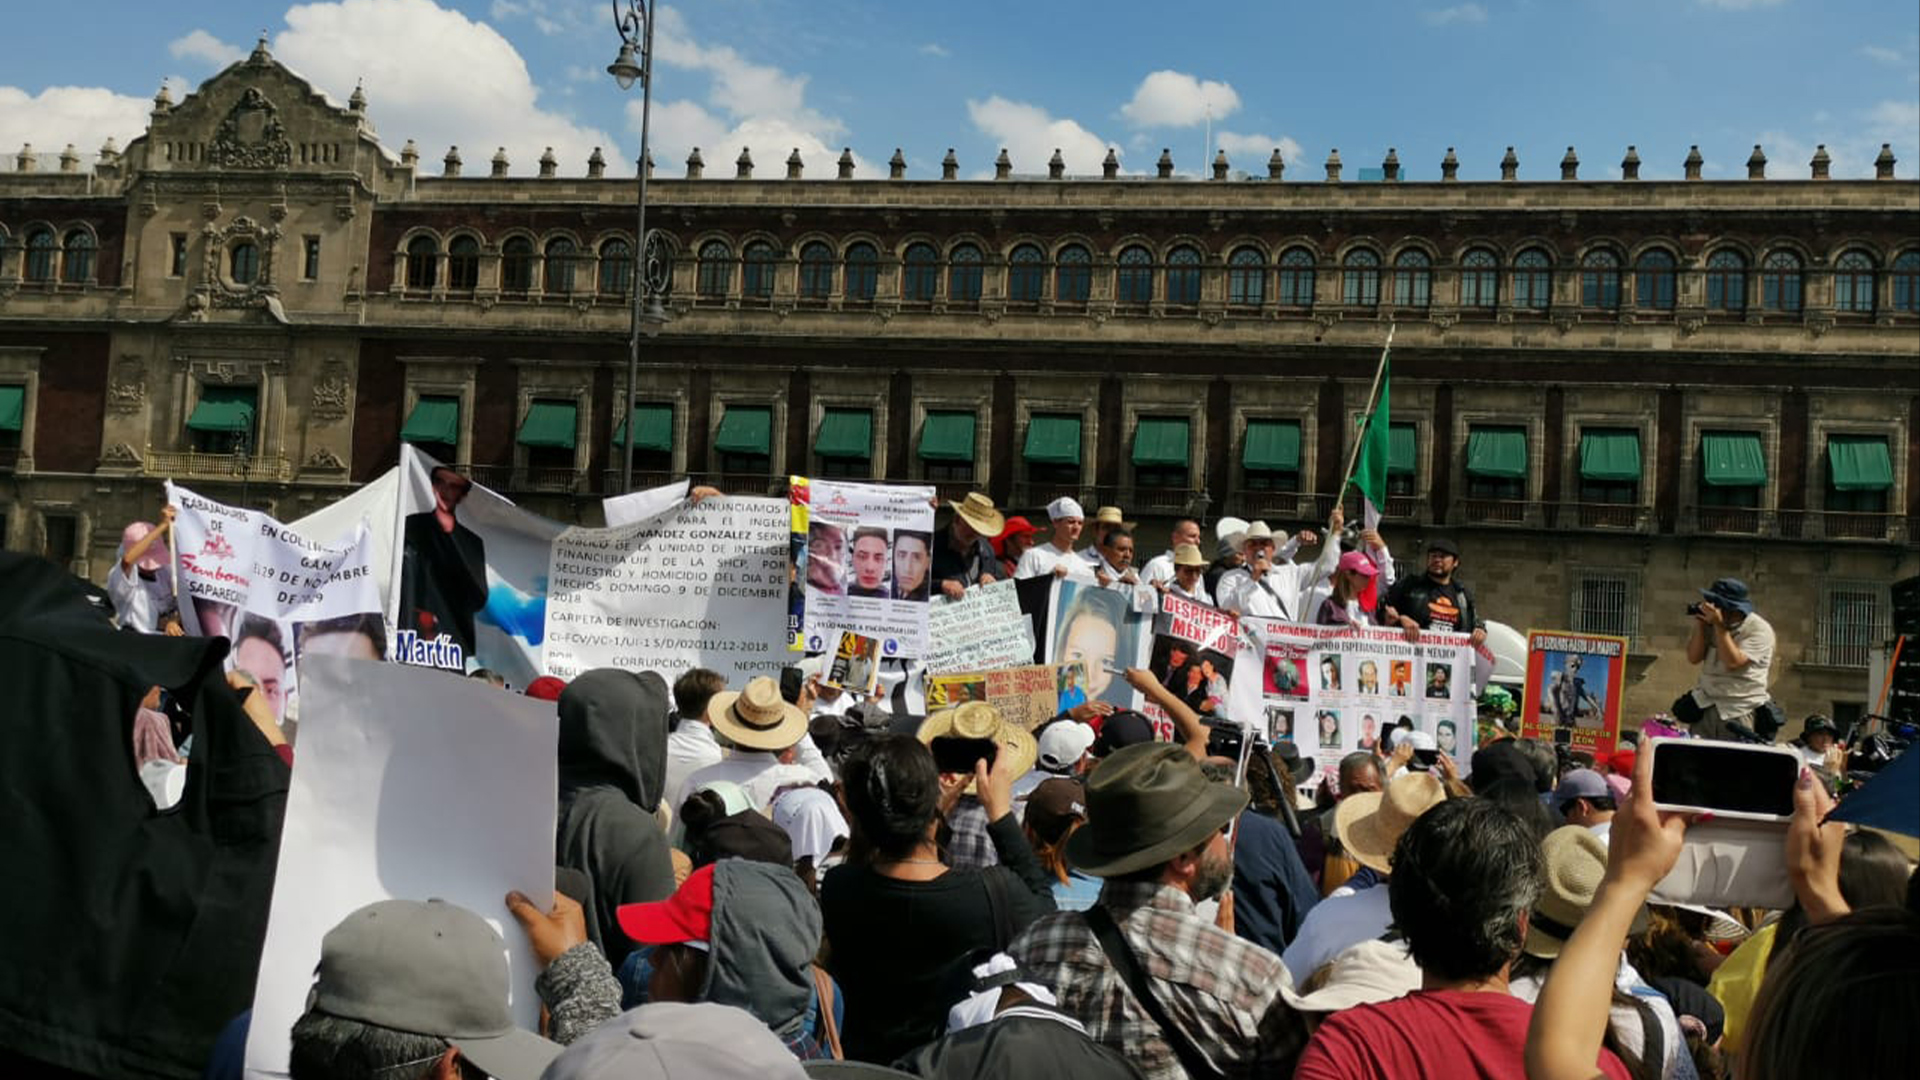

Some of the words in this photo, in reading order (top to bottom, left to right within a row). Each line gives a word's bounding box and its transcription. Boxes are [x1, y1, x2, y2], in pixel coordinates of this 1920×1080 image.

[683, 501, 781, 516] PRONUNCIAMOS
[211, 519, 223, 535] DE
[677, 515, 708, 526] PARA
[722, 516, 734, 527] EL
[261, 524, 278, 538] EN
[689, 529, 752, 542] GONZALEZ
[615, 540, 632, 553] DE
[638, 544, 652, 554] LA
[659, 543, 706, 555] UNIDAD
[711, 543, 726, 555] DE
[662, 557, 678, 569] DE
[690, 557, 705, 568] LA
[762, 560, 787, 572] POR
[263, 566, 276, 579] 29
[279, 570, 299, 586] DE
[303, 564, 370, 590] NOMBRE
[555, 562, 623, 579] SECUESTRO
[628, 570, 636, 579] Y
[641, 571, 708, 584] HOMICIDIO
[714, 572, 735, 584] DEL
[741, 573, 763, 585] DIA
[768, 574, 786, 586] DE
[554, 577, 602, 593] HECHOS
[678, 584, 688, 596] 9
[694, 585, 709, 597] DE
[717, 586, 783, 600] DICIEMBRE
[277, 591, 298, 606] DE
[552, 591, 582, 605] 2018
[551, 611, 603, 626] CARPETA
[606, 616, 623, 628] DE
[1164, 595, 1240, 638] DESPIERTA
[1172, 618, 1229, 651] MEXIO
[1373, 630, 1407, 645] ESPERAN
[397, 632, 462, 669] Martín
[1385, 643, 1412, 656] ESTADO
